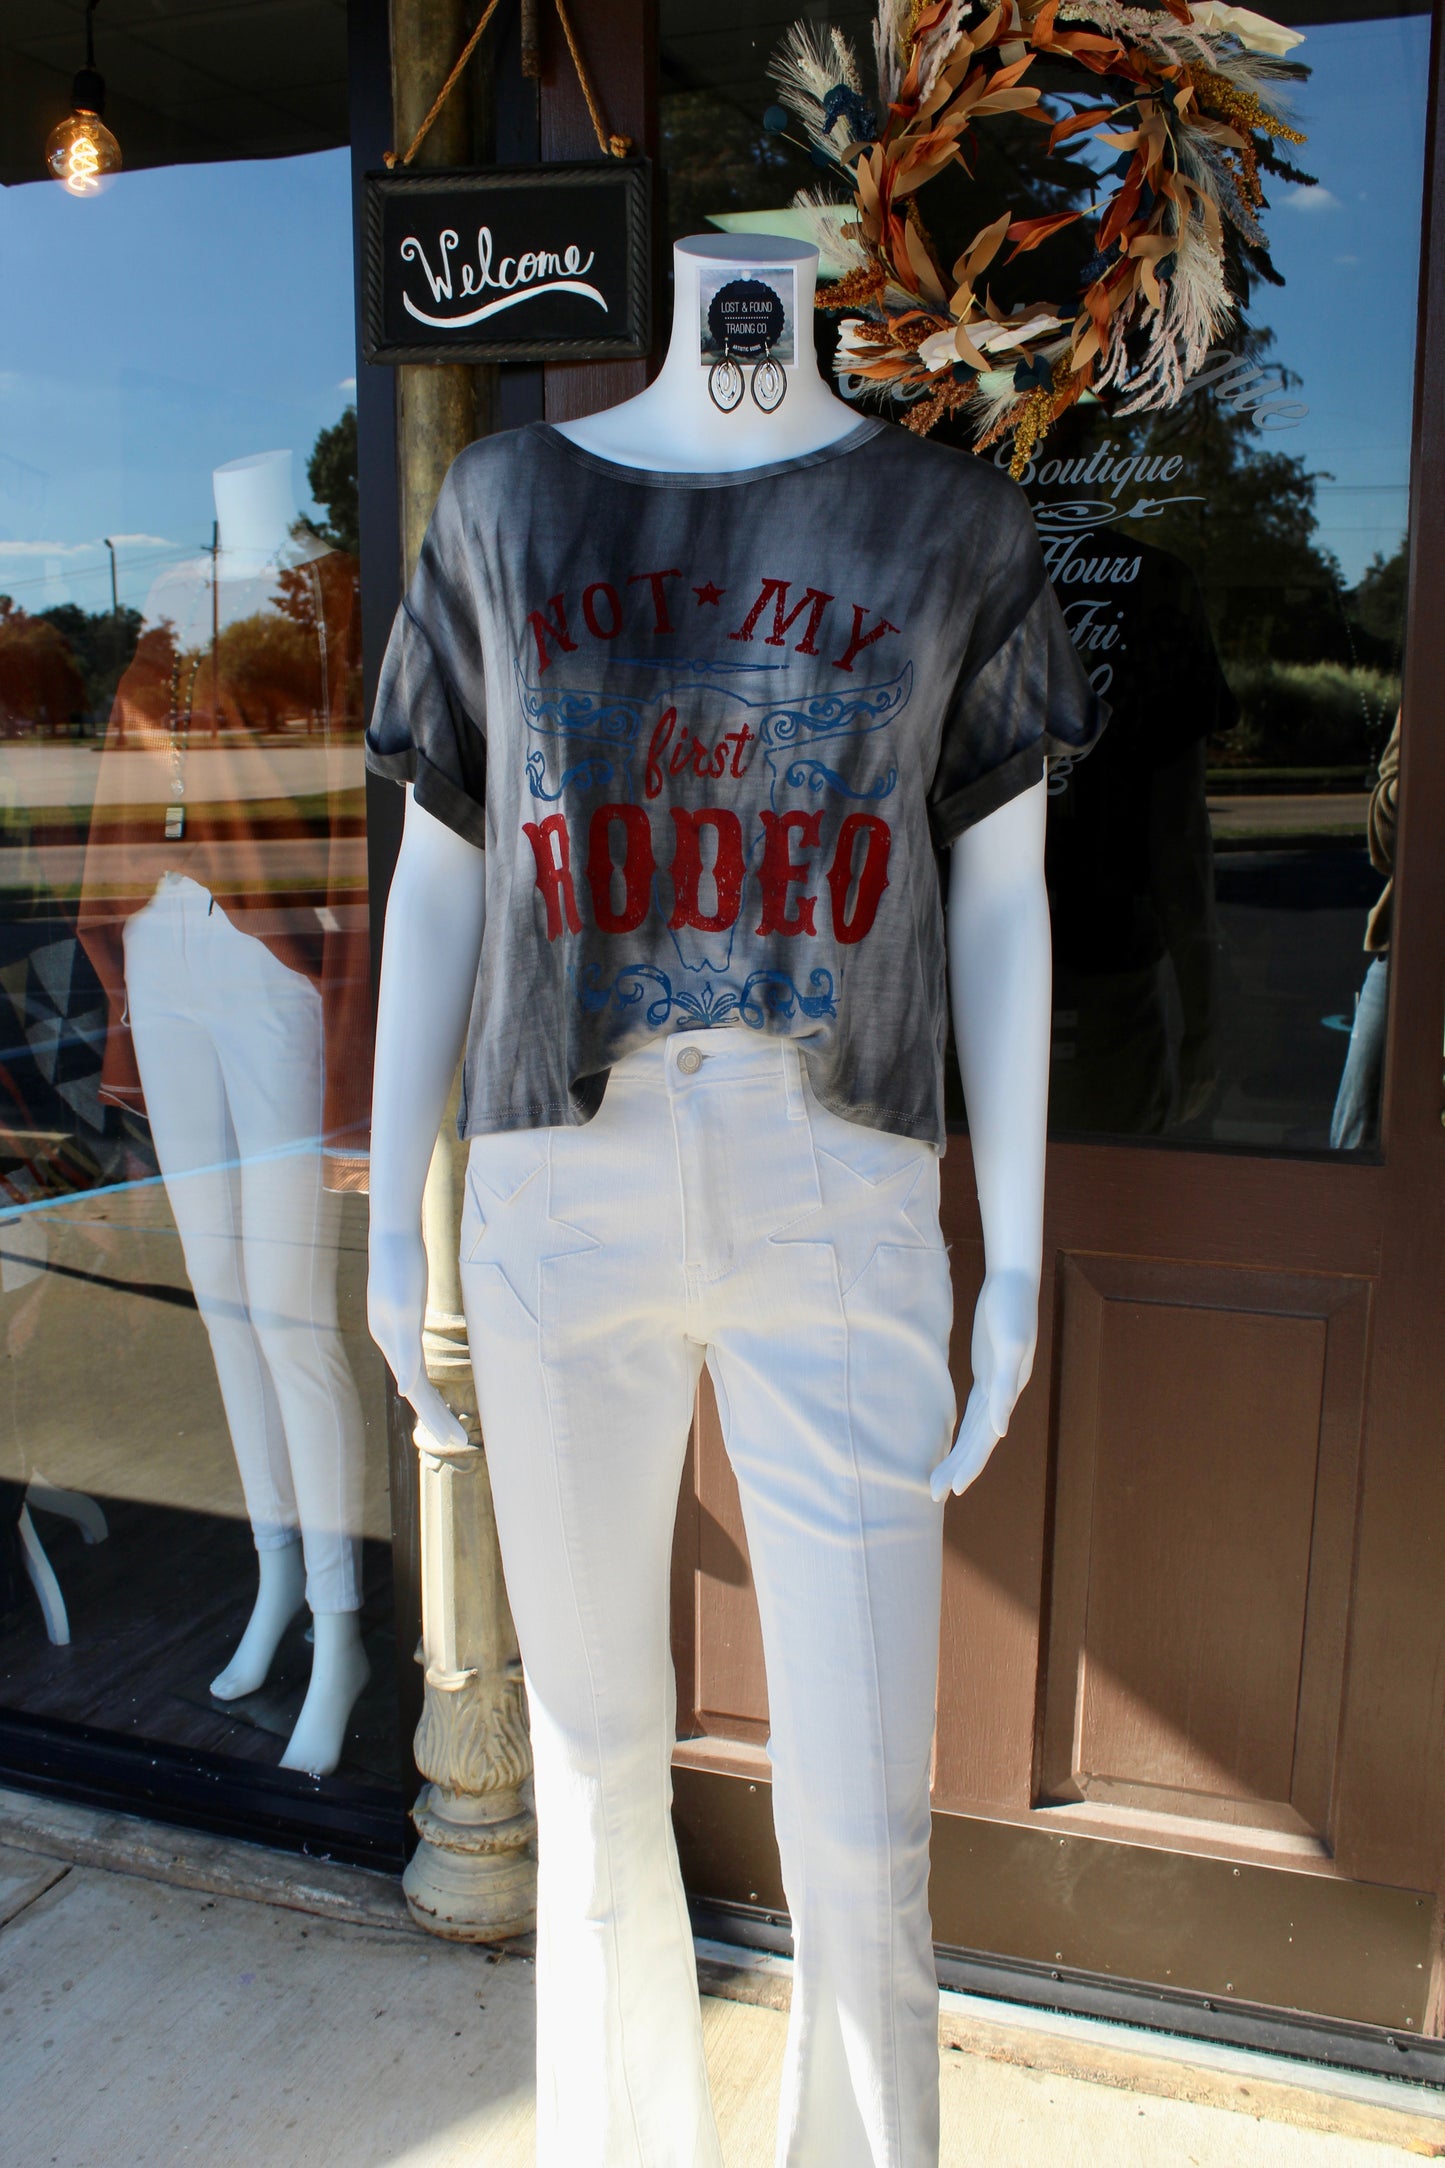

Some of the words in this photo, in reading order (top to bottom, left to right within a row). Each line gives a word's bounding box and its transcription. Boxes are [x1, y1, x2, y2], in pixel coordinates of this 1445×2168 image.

[400, 226, 595, 303] Welcome
[720, 301, 739, 313] LOST
[741, 301, 748, 313] &
[749, 301, 773, 313] FOUND
[725, 323, 756, 334] TRADING
[994, 438, 1184, 499] Boutique
[1038, 532, 1143, 584] Hours
[526, 569, 684, 677] NOT
[726, 577, 901, 673] MY
[644, 706, 756, 800] first
[521, 803, 891, 945] RODEO
